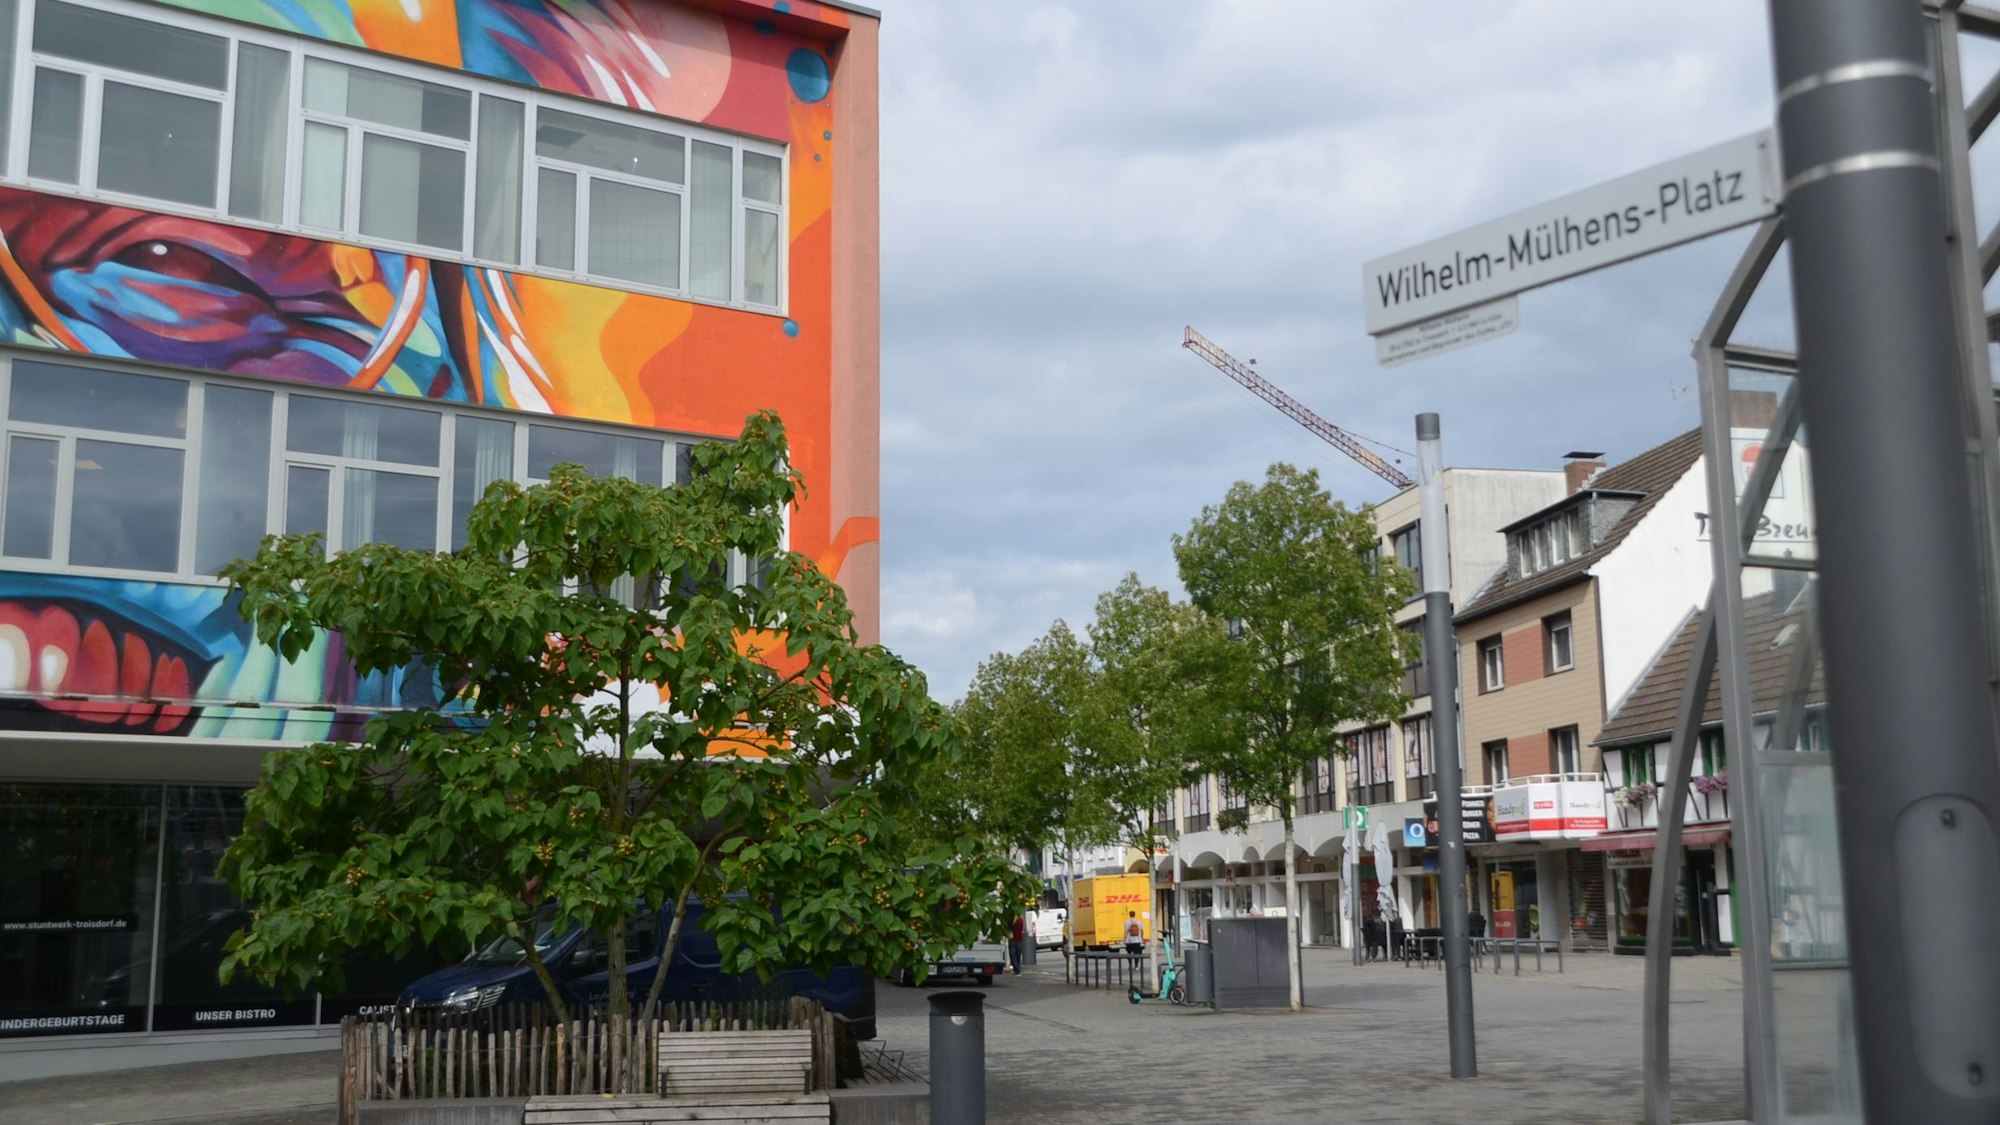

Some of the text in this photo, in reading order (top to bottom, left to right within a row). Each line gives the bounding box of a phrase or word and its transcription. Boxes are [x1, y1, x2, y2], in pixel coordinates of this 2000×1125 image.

[1377, 168, 1744, 309] Wilhelm-Mülhens-Platz
[1105, 894, 1142, 904] DHL
[4, 919, 128, 930] www.stuntwerk-troisdorf.de
[195, 1008, 276, 1021] UNSER BISTRO
[360, 1004, 397, 1015] CALIST
[0, 1014, 126, 1030] INDERGEBURTSTAGE
